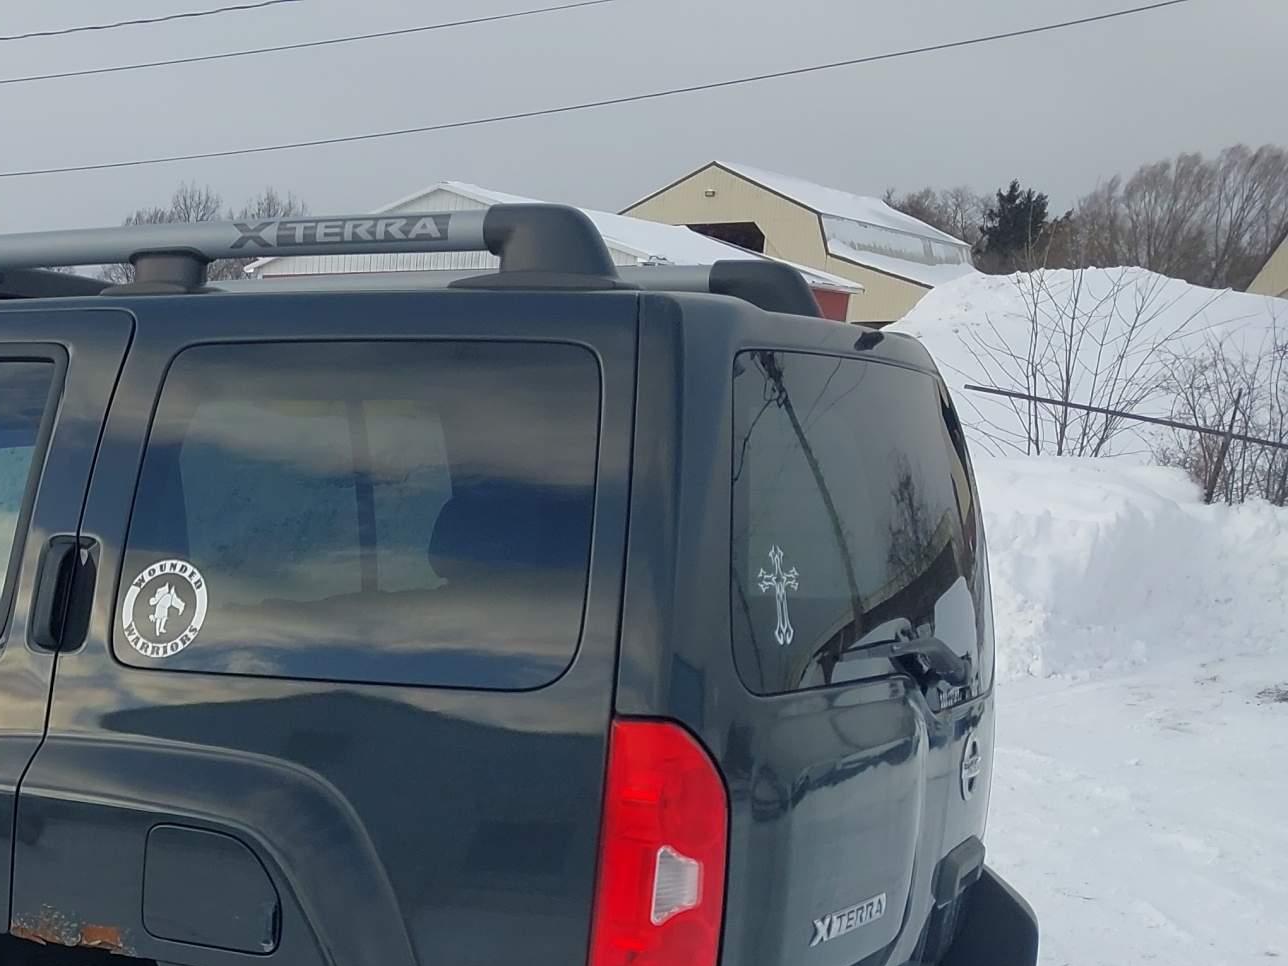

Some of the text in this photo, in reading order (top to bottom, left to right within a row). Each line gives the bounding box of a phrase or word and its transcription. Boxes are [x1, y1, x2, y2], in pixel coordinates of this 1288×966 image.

[230, 215, 442, 249] XTERRA
[132, 562, 203, 590] WOUNDED
[124, 622, 199, 657] WARRIORS
[809, 892, 887, 948] XTERRA
